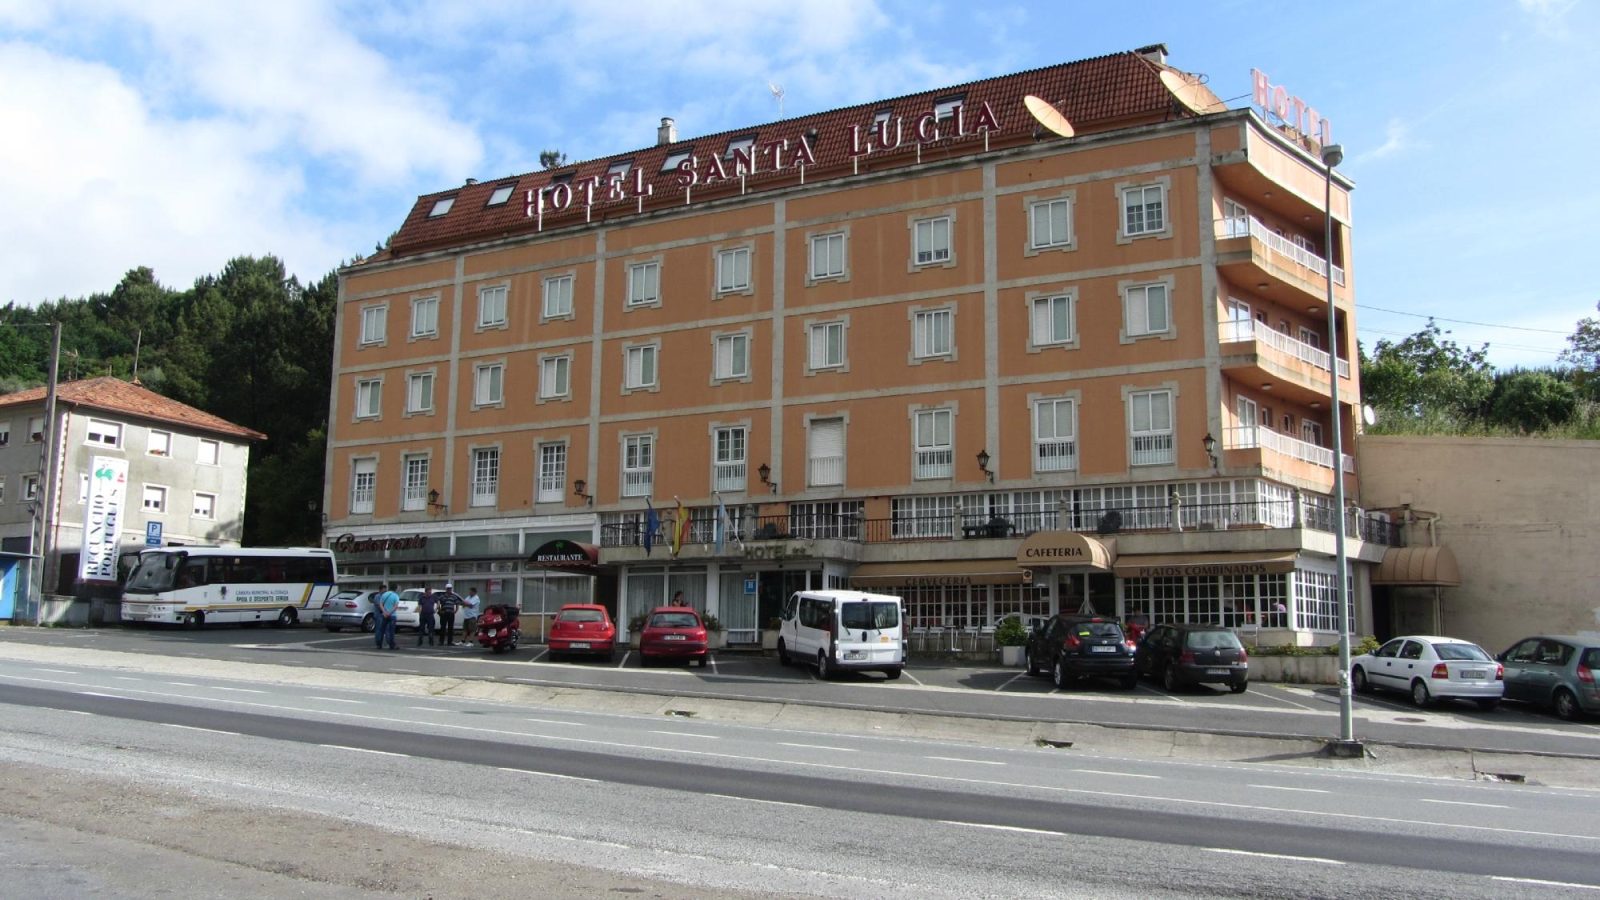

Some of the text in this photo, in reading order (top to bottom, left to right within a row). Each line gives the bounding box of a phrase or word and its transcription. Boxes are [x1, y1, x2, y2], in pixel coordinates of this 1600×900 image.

[522, 101, 1001, 218] HOTEL SANTA LUCIA
[86, 494, 105, 576] RECUNCHO
[537, 554, 584, 562] RESTAURANTE
[1026, 547, 1083, 558] CAFETERIA
[1140, 564, 1266, 577] PLATOS COMBINADOS
[905, 576, 972, 586] CERVECERIA
